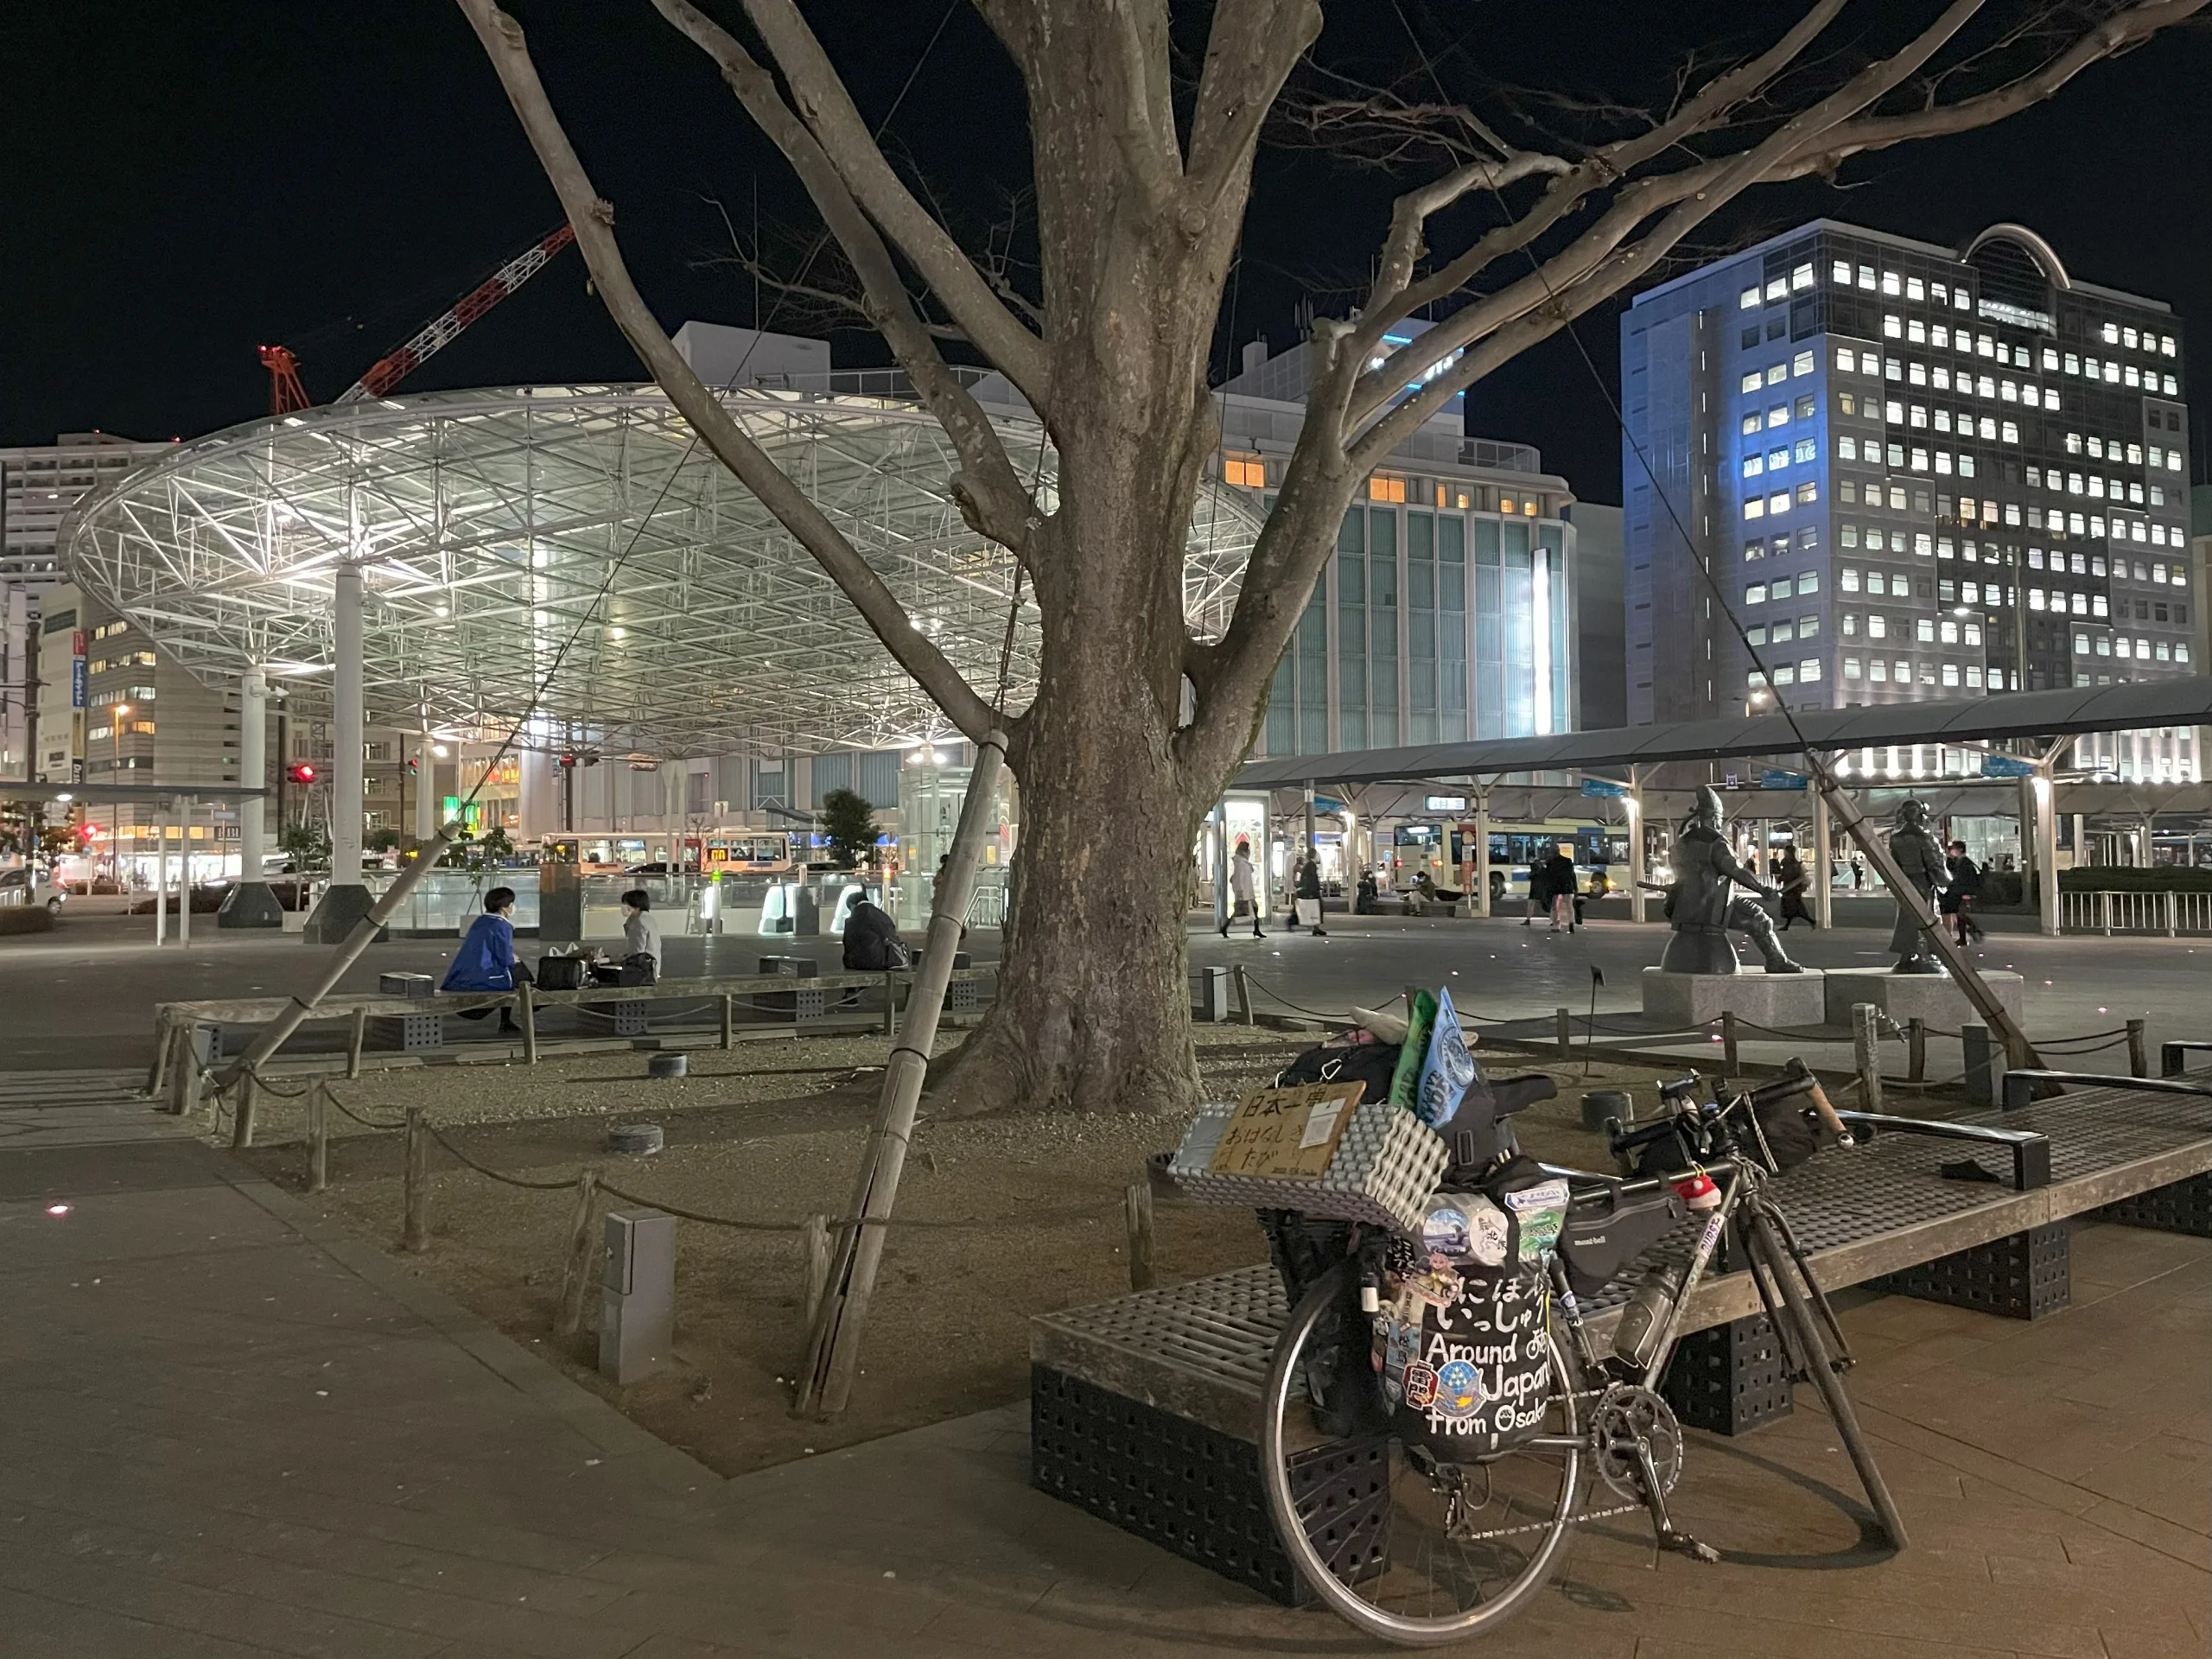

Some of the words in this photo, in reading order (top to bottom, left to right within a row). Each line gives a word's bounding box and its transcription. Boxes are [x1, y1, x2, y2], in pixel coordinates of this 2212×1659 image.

[1457, 1273, 1544, 1304] にほん
[1427, 1333, 1518, 1365] Around
[1482, 1361, 1551, 1407] Japan
[1426, 1408, 1487, 1436] from
